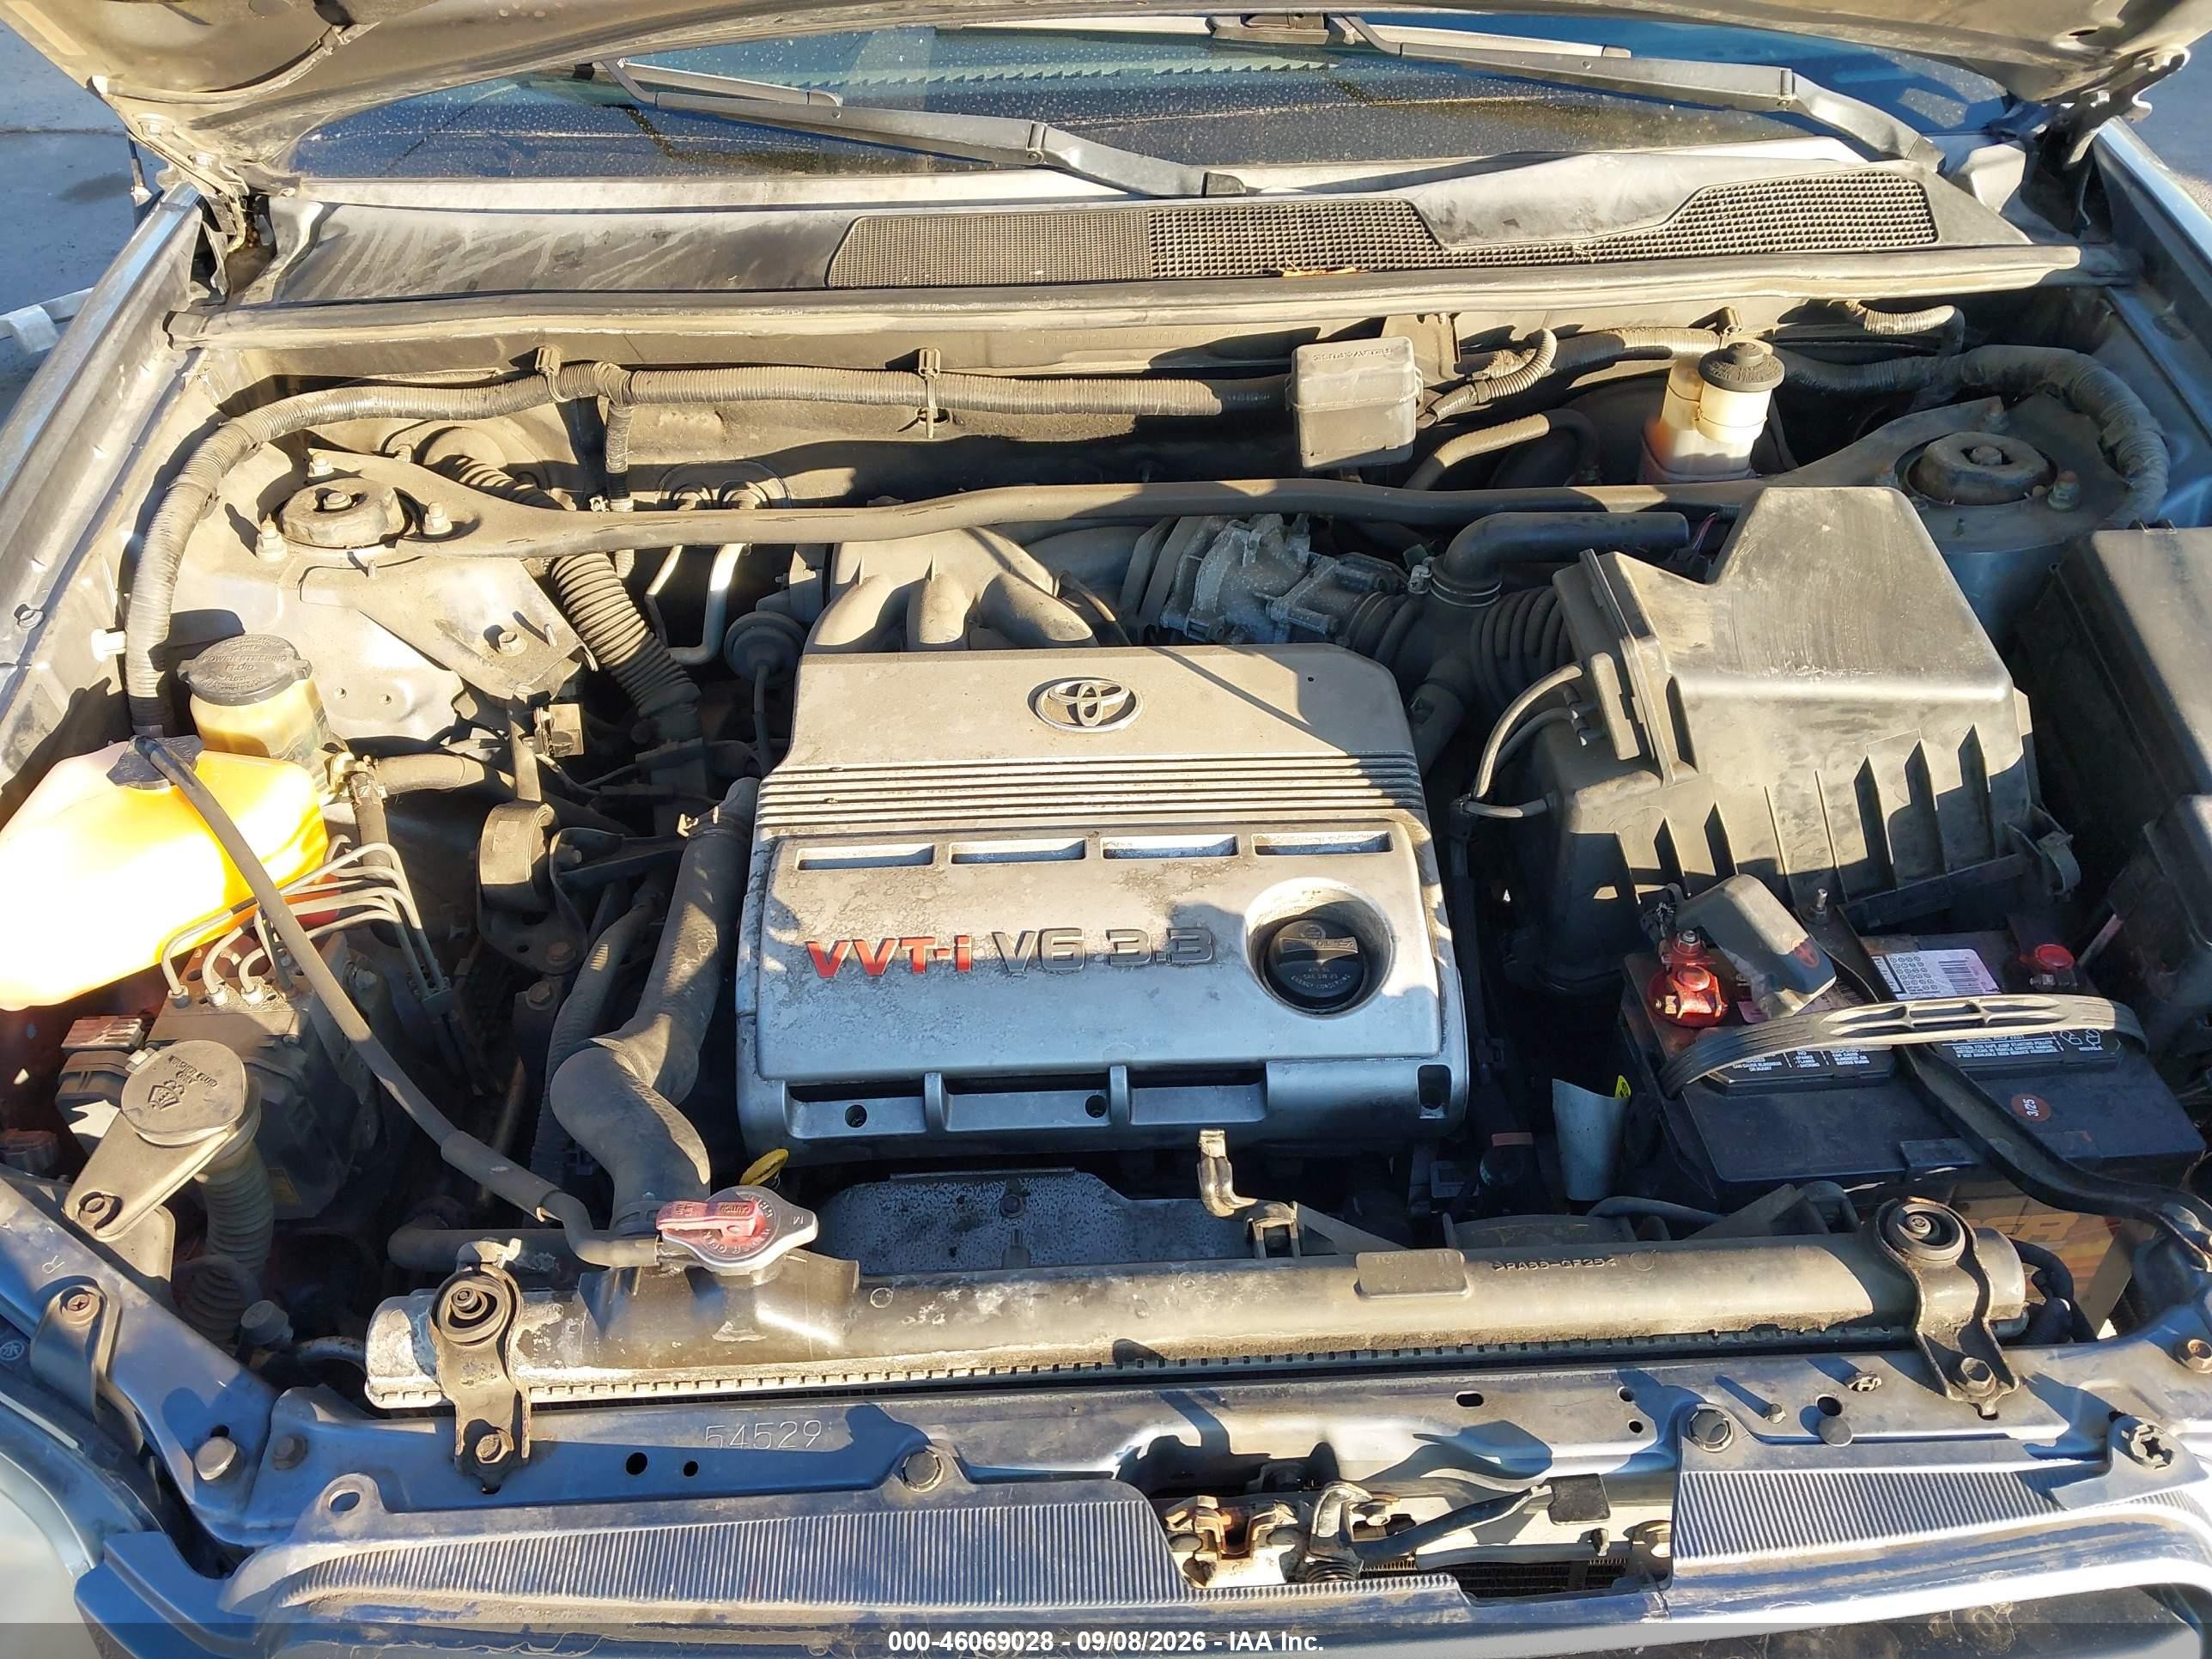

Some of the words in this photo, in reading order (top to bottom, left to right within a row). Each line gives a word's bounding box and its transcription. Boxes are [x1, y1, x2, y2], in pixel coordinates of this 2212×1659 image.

[805, 934, 973, 979] VVT-i
[992, 927, 1087, 975] V6
[1105, 927, 1216, 967] 3.3
[2022, 1098, 2040, 1117] 3/25
